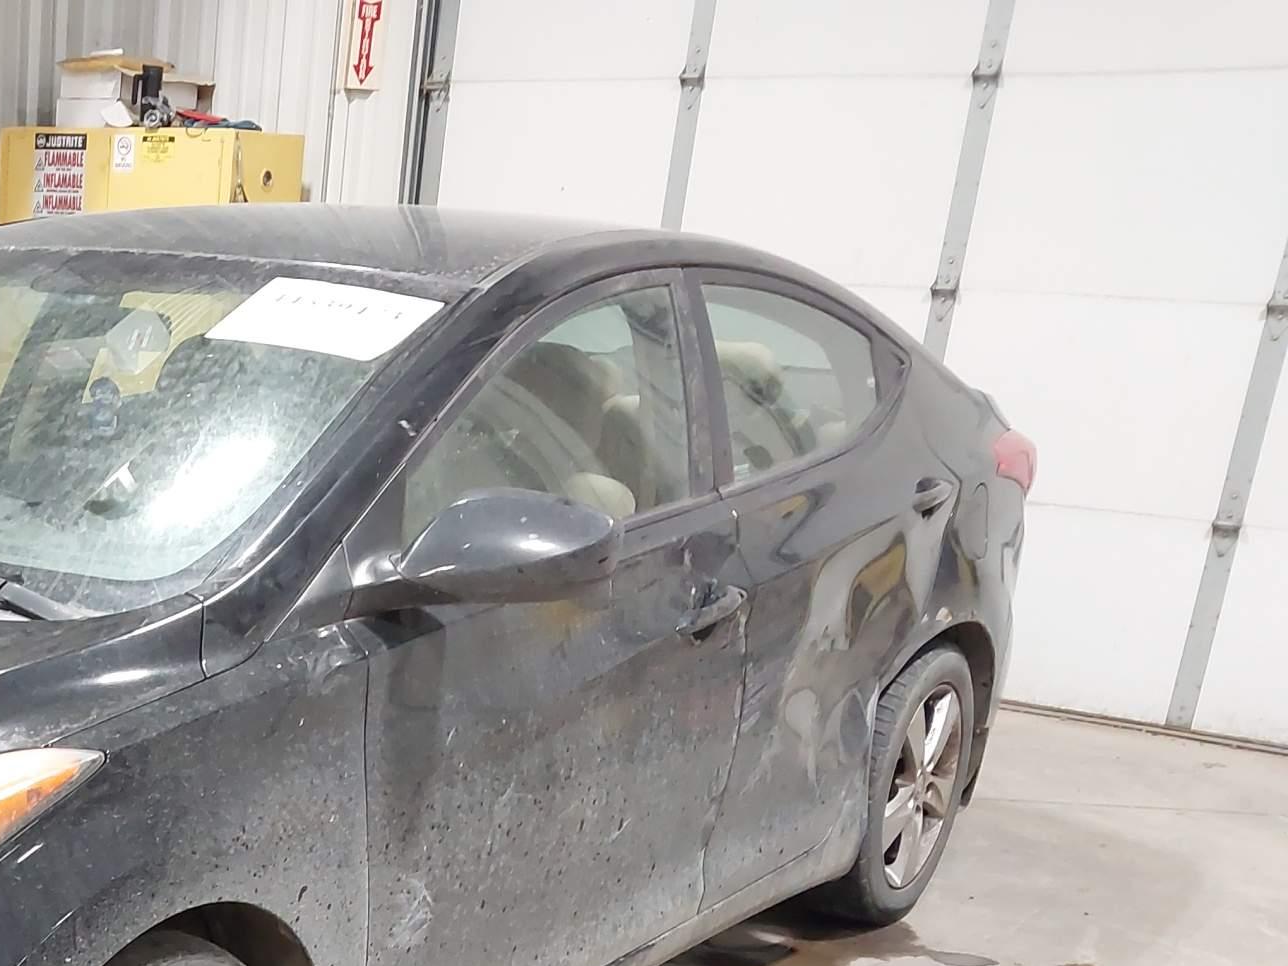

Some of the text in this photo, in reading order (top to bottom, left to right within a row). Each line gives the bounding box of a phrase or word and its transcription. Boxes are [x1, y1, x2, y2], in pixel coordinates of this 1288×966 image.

[44, 151, 84, 167] FLAMMABLE
[43, 173, 83, 189] INFLAMABLE
[42, 194, 82, 211] INFLAMMABLE
